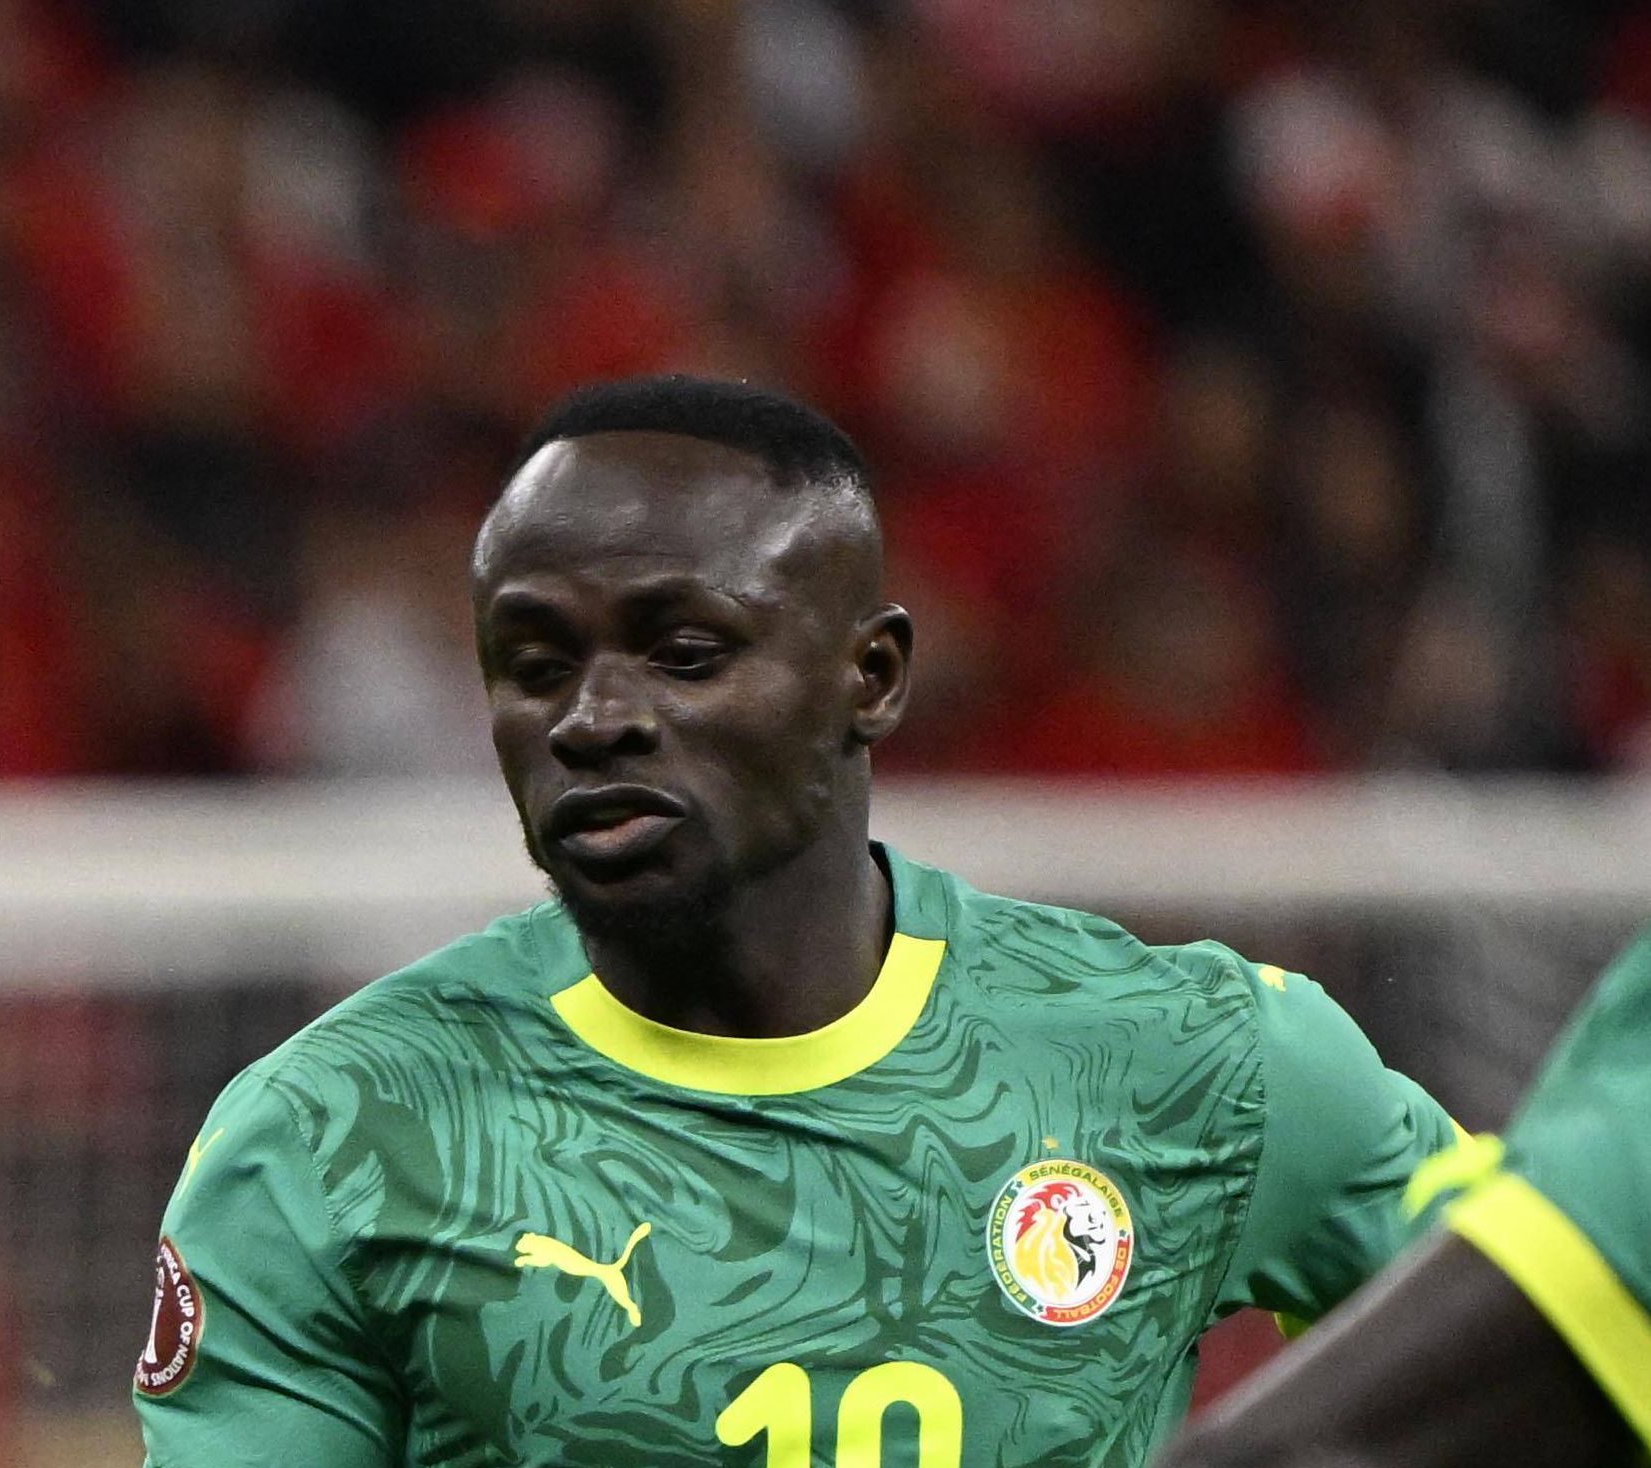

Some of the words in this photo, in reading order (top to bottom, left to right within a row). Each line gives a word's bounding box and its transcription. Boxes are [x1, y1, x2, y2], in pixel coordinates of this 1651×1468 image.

[1029, 1163, 1125, 1219] SÉNÉGALAISE
[1114, 1249, 1128, 1274] DE
[176, 1284, 195, 1318] CUP
[1053, 1275, 1120, 1320] FOOTBALL
[179, 1320, 195, 1345] OF
[150, 1344, 189, 1387] NATIONS
